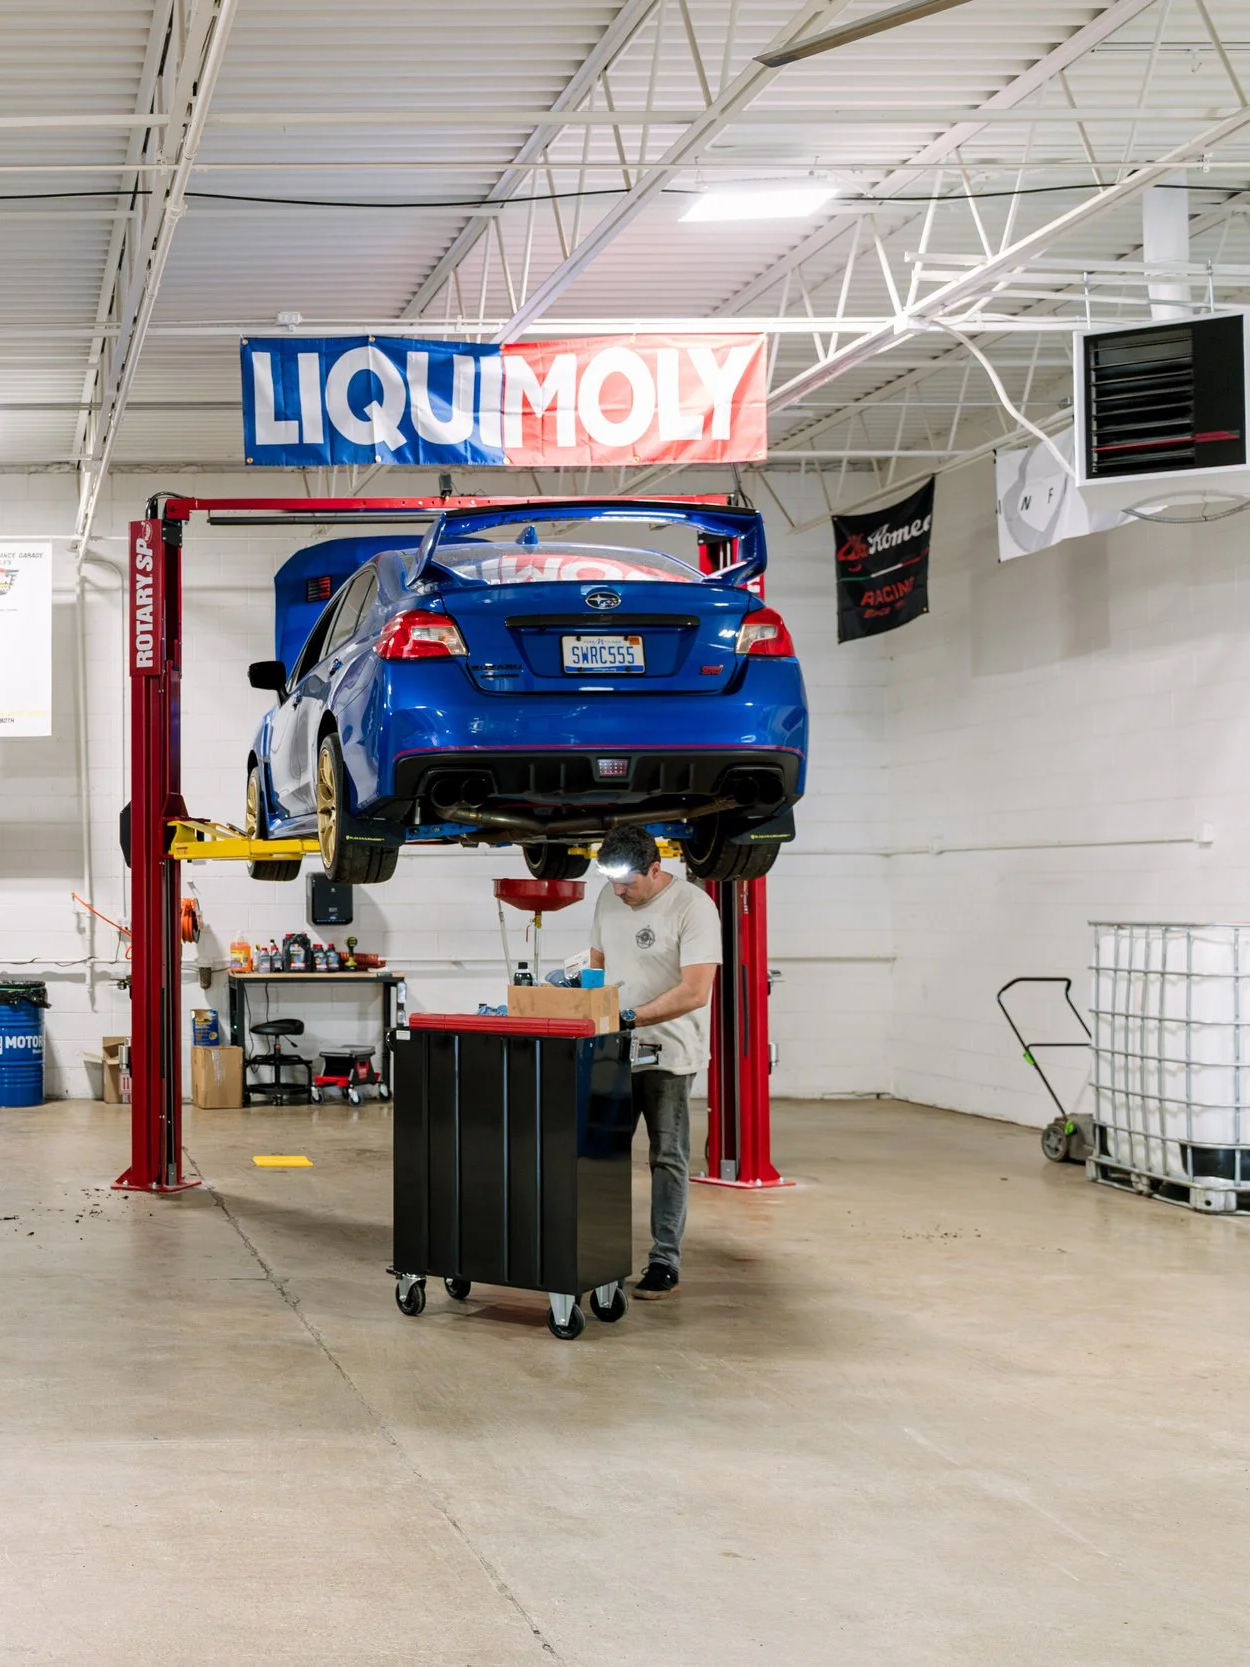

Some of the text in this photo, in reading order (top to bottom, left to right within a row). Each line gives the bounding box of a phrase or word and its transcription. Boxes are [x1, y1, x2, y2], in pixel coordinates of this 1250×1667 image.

[135, 537, 153, 668] ROTARY SP
[861, 575, 915, 607] RACIN
[572, 646, 635, 664] SWRC555
